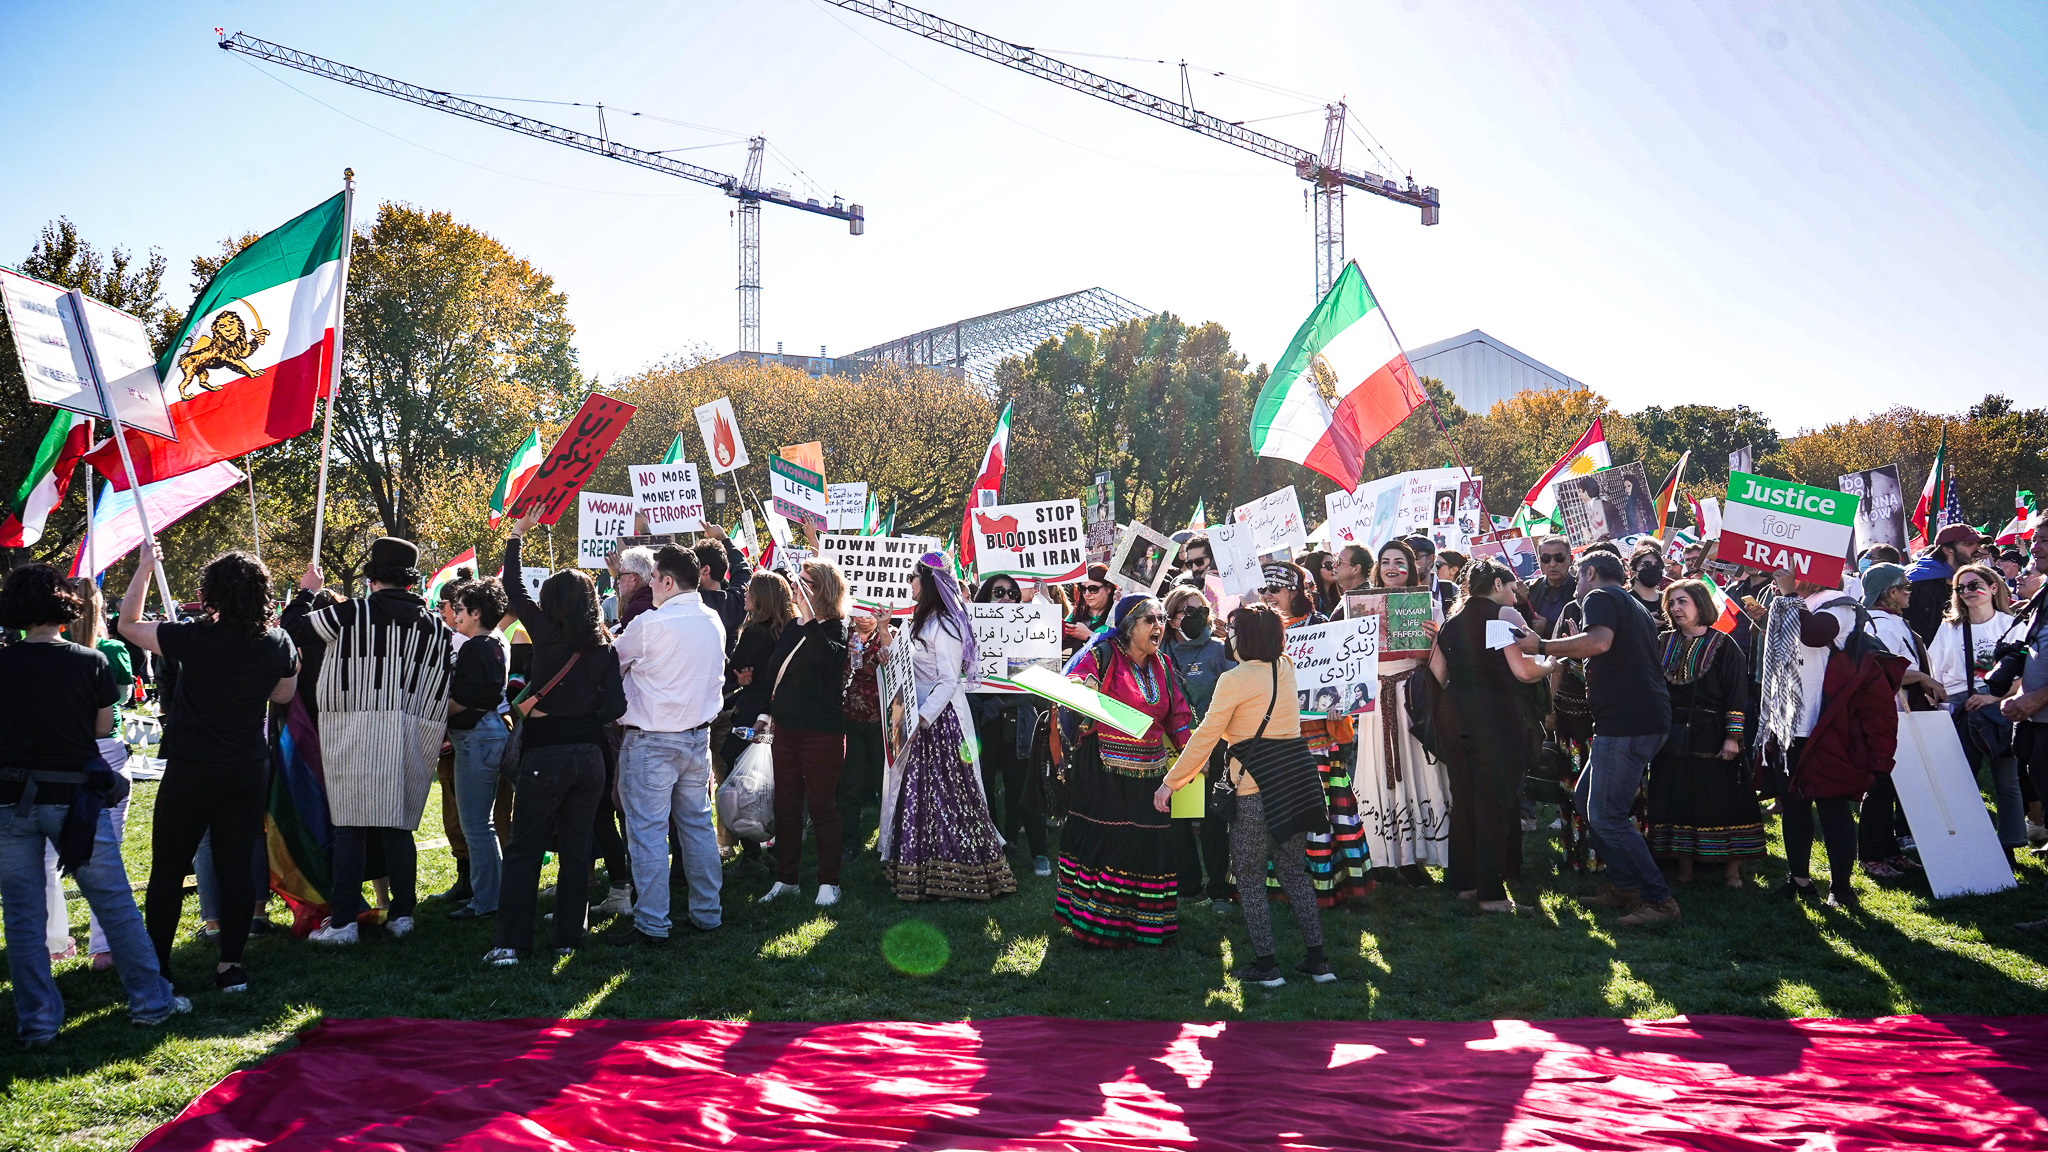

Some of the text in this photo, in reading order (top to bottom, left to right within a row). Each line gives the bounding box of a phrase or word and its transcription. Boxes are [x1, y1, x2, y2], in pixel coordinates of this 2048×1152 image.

[578, 402, 622, 440] زن
[639, 470, 692, 486] NO MORE
[775, 458, 818, 486] WOMAN
[784, 479, 811, 500] LIFE
[1844, 477, 1864, 490] DO
[642, 489, 697, 503] MONEY FOR
[1332, 490, 1364, 514] HOW
[1741, 480, 1836, 515] Justice
[588, 498, 633, 516] WOMAN
[644, 504, 702, 524] TERRORIST
[776, 499, 826, 527] FREEOM
[1036, 505, 1074, 523] STOP
[595, 519, 625, 536] LIFE
[1219, 525, 1234, 541] زن
[1762, 515, 1800, 539] for
[825, 539, 928, 554] DOWN WITH
[986, 527, 1077, 550] BLOODSHED
[582, 539, 617, 557] FREED
[838, 555, 912, 568] ISLAMIC
[1019, 548, 1080, 568] IN IRAN
[1743, 540, 1812, 575] IRAN
[844, 570, 913, 583] EPUBLIC
[867, 586, 907, 598] IRAN
[970, 606, 1041, 623] هرگز کشتار
[1395, 608, 1425, 616] WOMAN
[1000, 627, 1009, 643] را
[1014, 627, 1057, 643] زاهدان
[1358, 617, 1376, 635] زن
[1336, 634, 1375, 662] زندگی
[895, 652, 900, 665] BY
[1295, 657, 1330, 669] edom
[889, 650, 897, 690] ISLAMIC
[904, 639, 915, 707] TREATMENT OF
[1320, 657, 1364, 683] آزادی
[898, 630, 912, 734] POLITICAL PRISONERS
